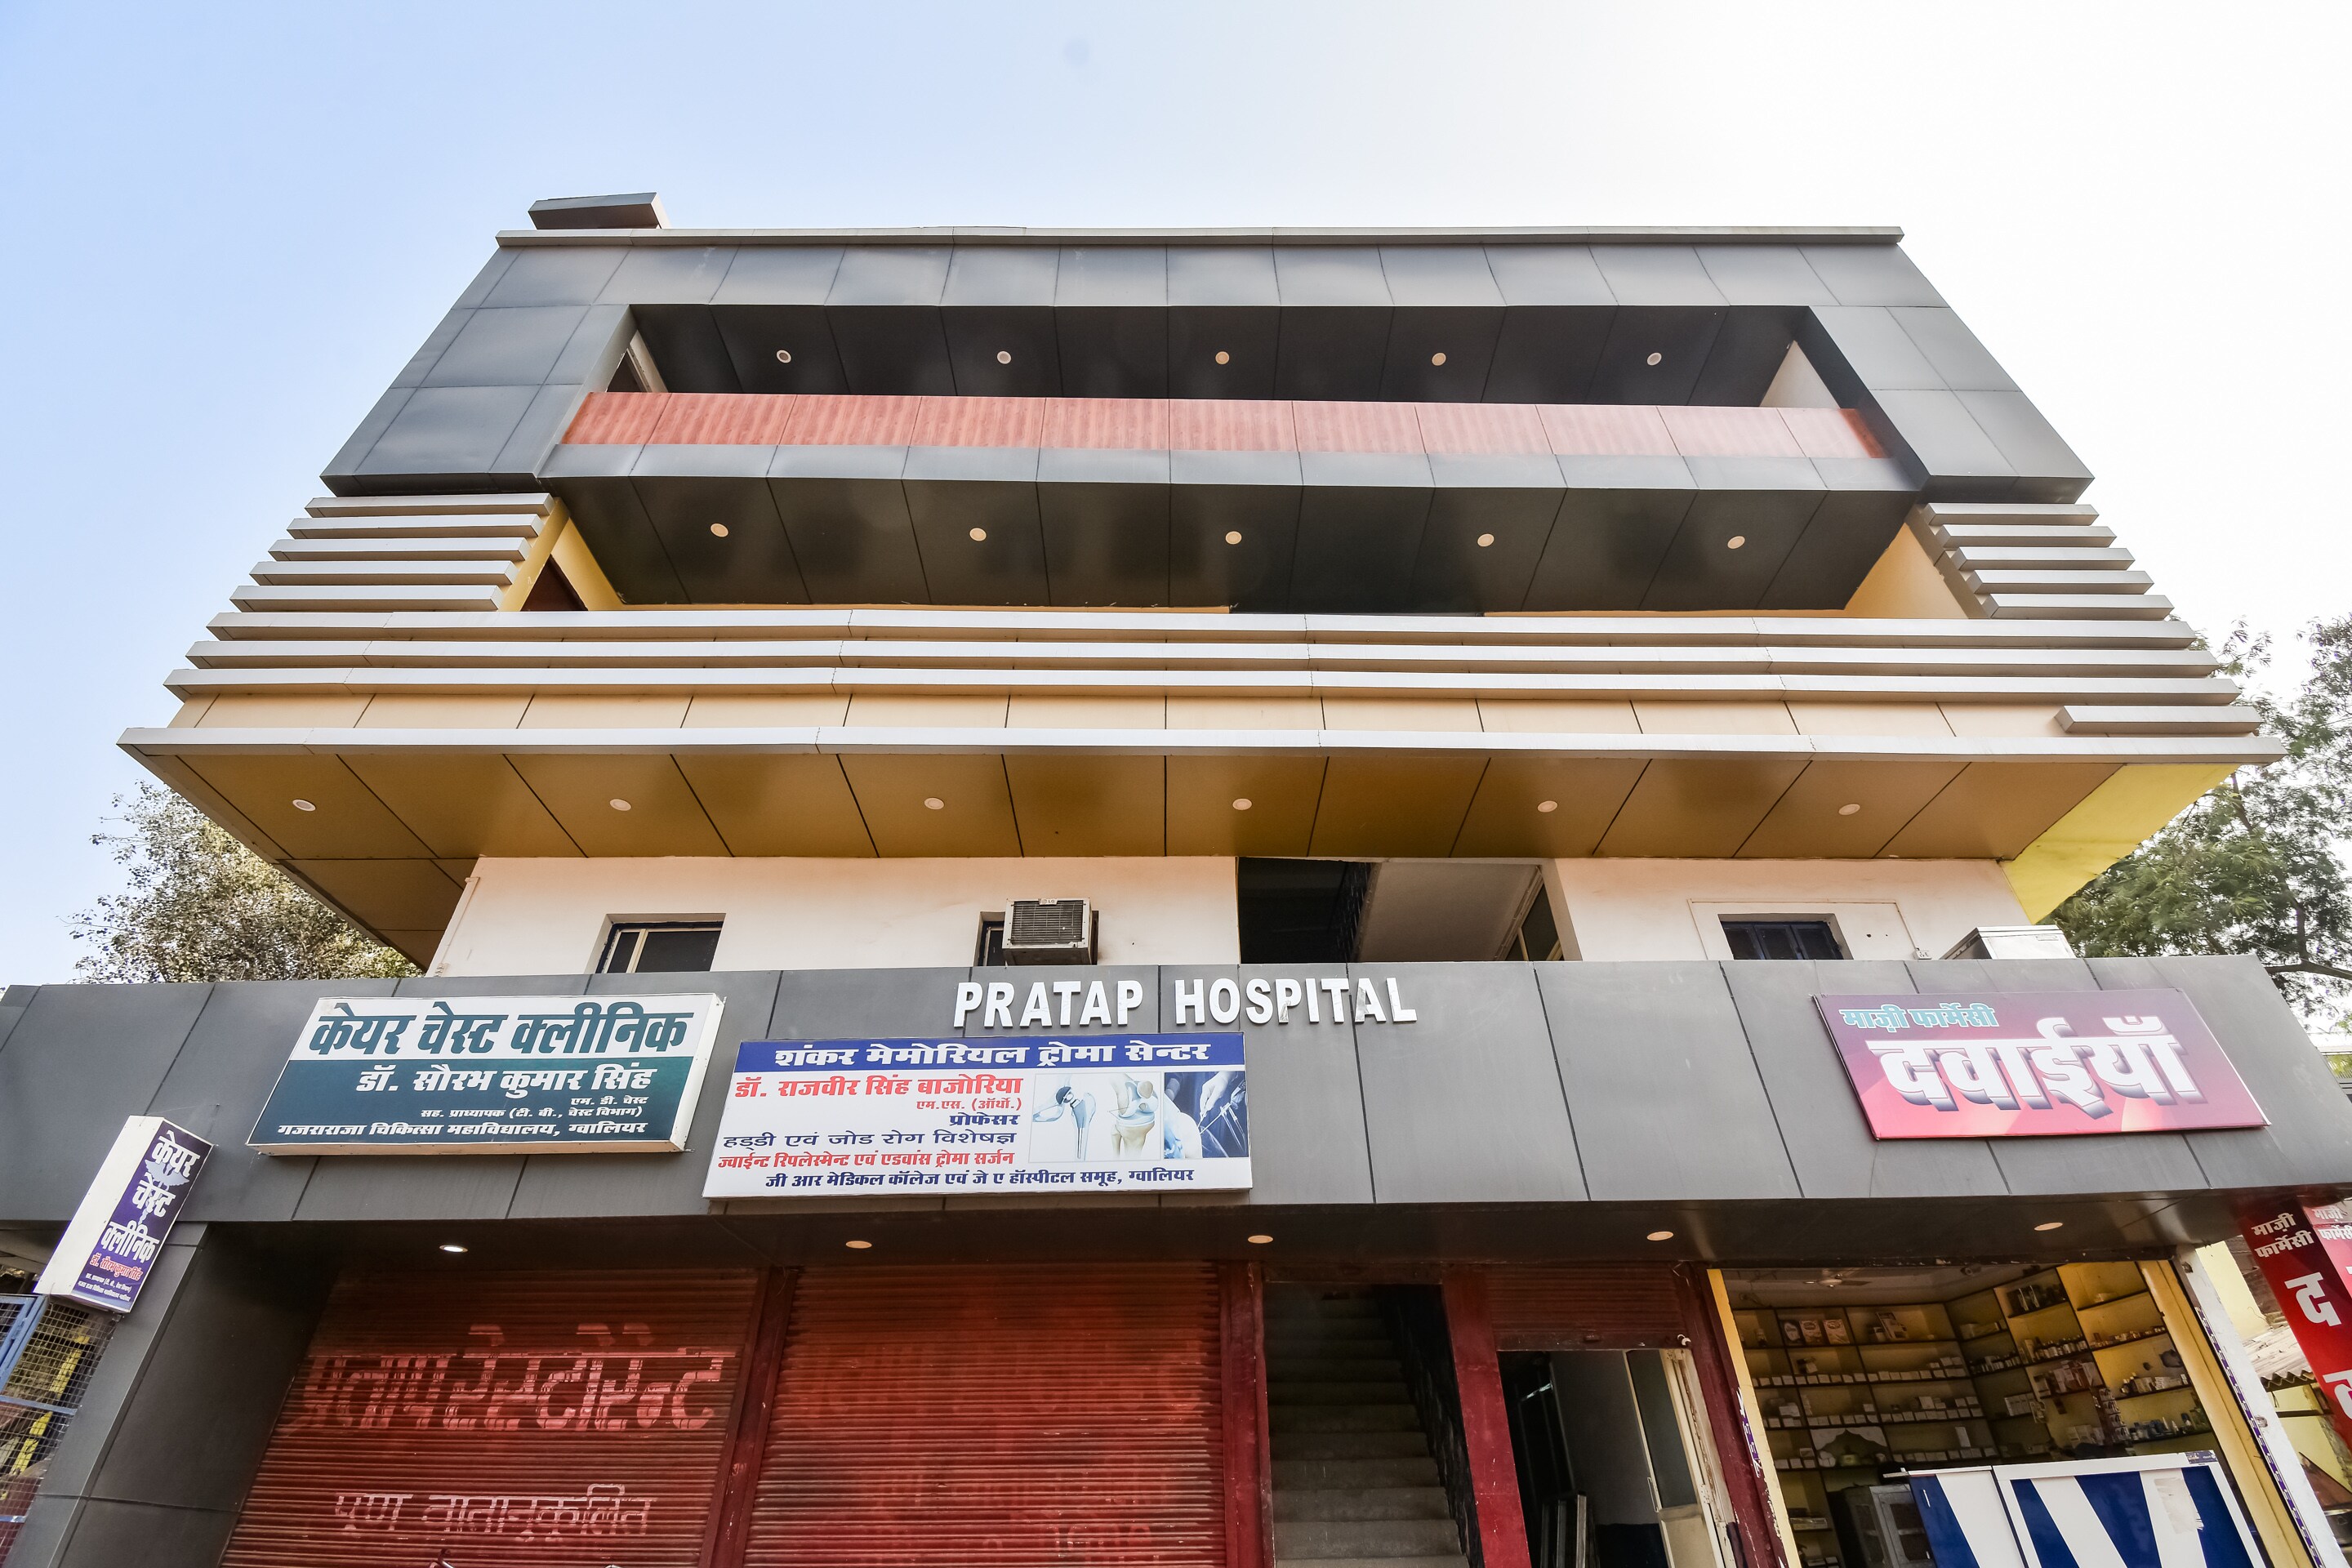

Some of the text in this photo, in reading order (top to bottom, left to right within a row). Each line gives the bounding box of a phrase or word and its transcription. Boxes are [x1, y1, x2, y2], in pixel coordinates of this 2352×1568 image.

[954, 978, 1419, 1028] PRATAP HOSPITAL
[1907, 1003, 1999, 1027] फार्मेसी
[309, 1001, 694, 1055] केयर चेस्ट क्लीनिक
[774, 1040, 1212, 1067] शंकर मेमोरियल ट्रोमा सेन्टर
[355, 1062, 658, 1099] डॉ. सौरभ कुमार सिंह
[734, 1073, 1024, 1098] डॉ. राजवीर सिंह बाजोरिया
[568, 1107, 595, 1117] चेस्ट
[595, 1106, 644, 1117] विभाग)
[623, 1094, 649, 1105] चेस्ट
[277, 1120, 649, 1136] गजराराजा चिकित्सा महाविद्यालय, ग्वालियर
[949, 1111, 1022, 1126] प्रोफेसर
[784, 1131, 819, 1147] एवं
[881, 1129, 926, 1144] रोग
[932, 1129, 1018, 1143] विशेषज्ञ
[151, 1129, 201, 1178] केयर
[853, 1150, 879, 1165] एवं
[880, 1150, 933, 1165] एडवांस
[934, 1149, 971, 1168] ट्रोमा
[973, 1148, 1015, 1165] सर्जन
[765, 1167, 1195, 1187] जी आर मेडिकल कॉलेज एवं जे ए हॉस्पीटल समूह, ग्वालियर
[131, 1171, 176, 1218] चेस्ट
[100, 1220, 160, 1263] क्लीनिक
[2254, 1230, 2314, 1258] फार्मेसी
